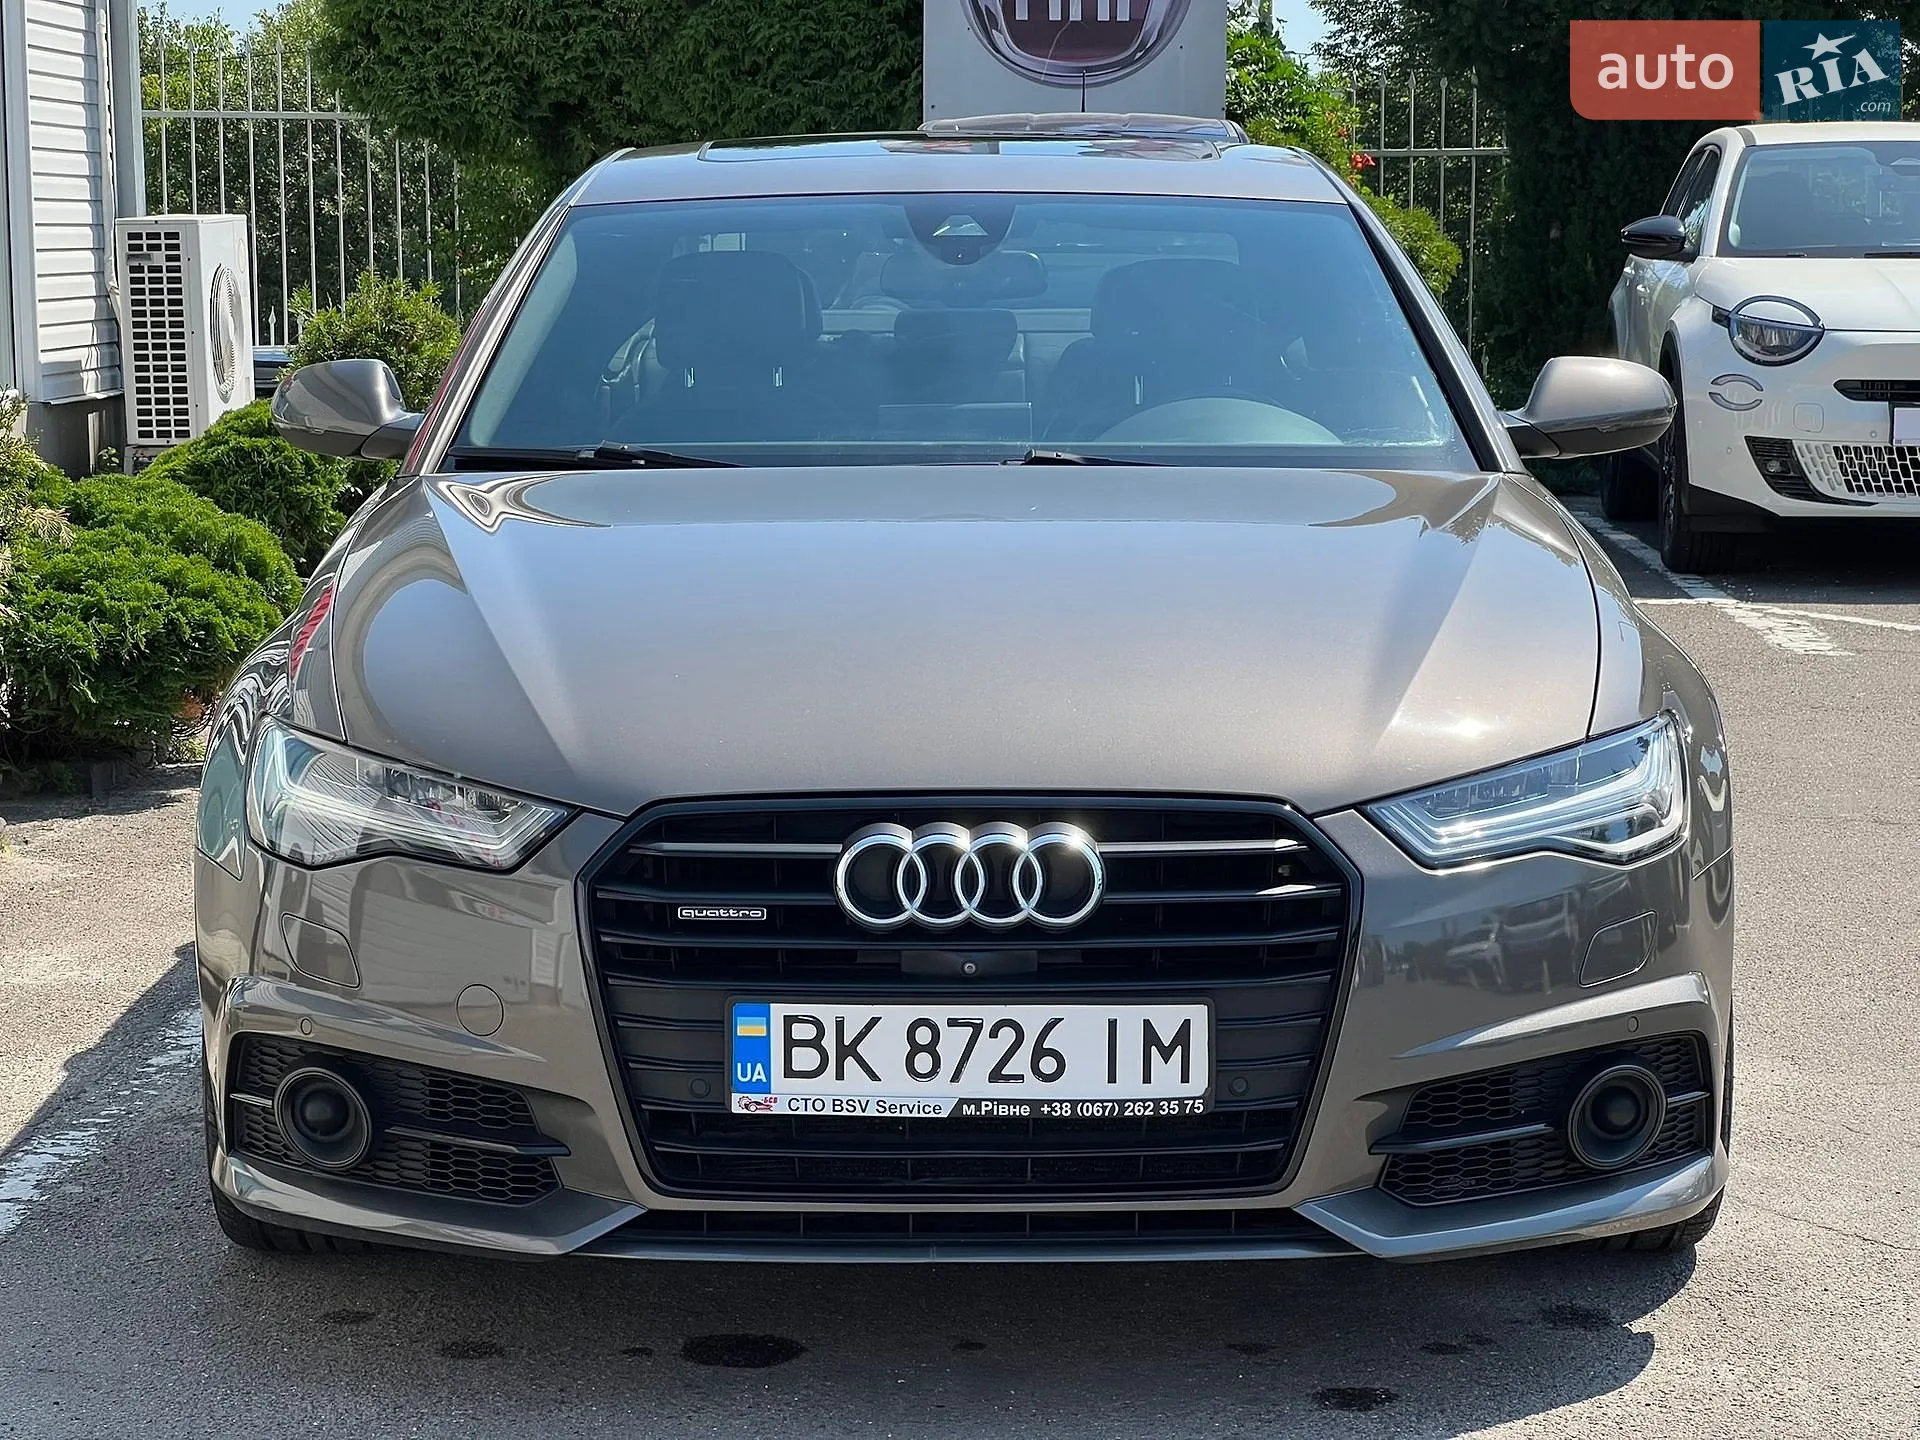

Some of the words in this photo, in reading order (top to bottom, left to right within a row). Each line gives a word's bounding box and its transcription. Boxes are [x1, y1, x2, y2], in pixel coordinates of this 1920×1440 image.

[681, 908, 763, 918] quattro
[783, 1014, 882, 1082] BK
[905, 1017, 1067, 1084] 8726
[736, 1062, 768, 1083] UA
[832, 1098, 869, 1114] BSV
[875, 1099, 942, 1115] Service
[1040, 1101, 1072, 1117] +38
[1076, 1101, 1119, 1117] (067)
[1124, 1101, 1154, 1116] 262
[1159, 1100, 1179, 1115] 35
[1183, 1099, 1204, 1114] 75
